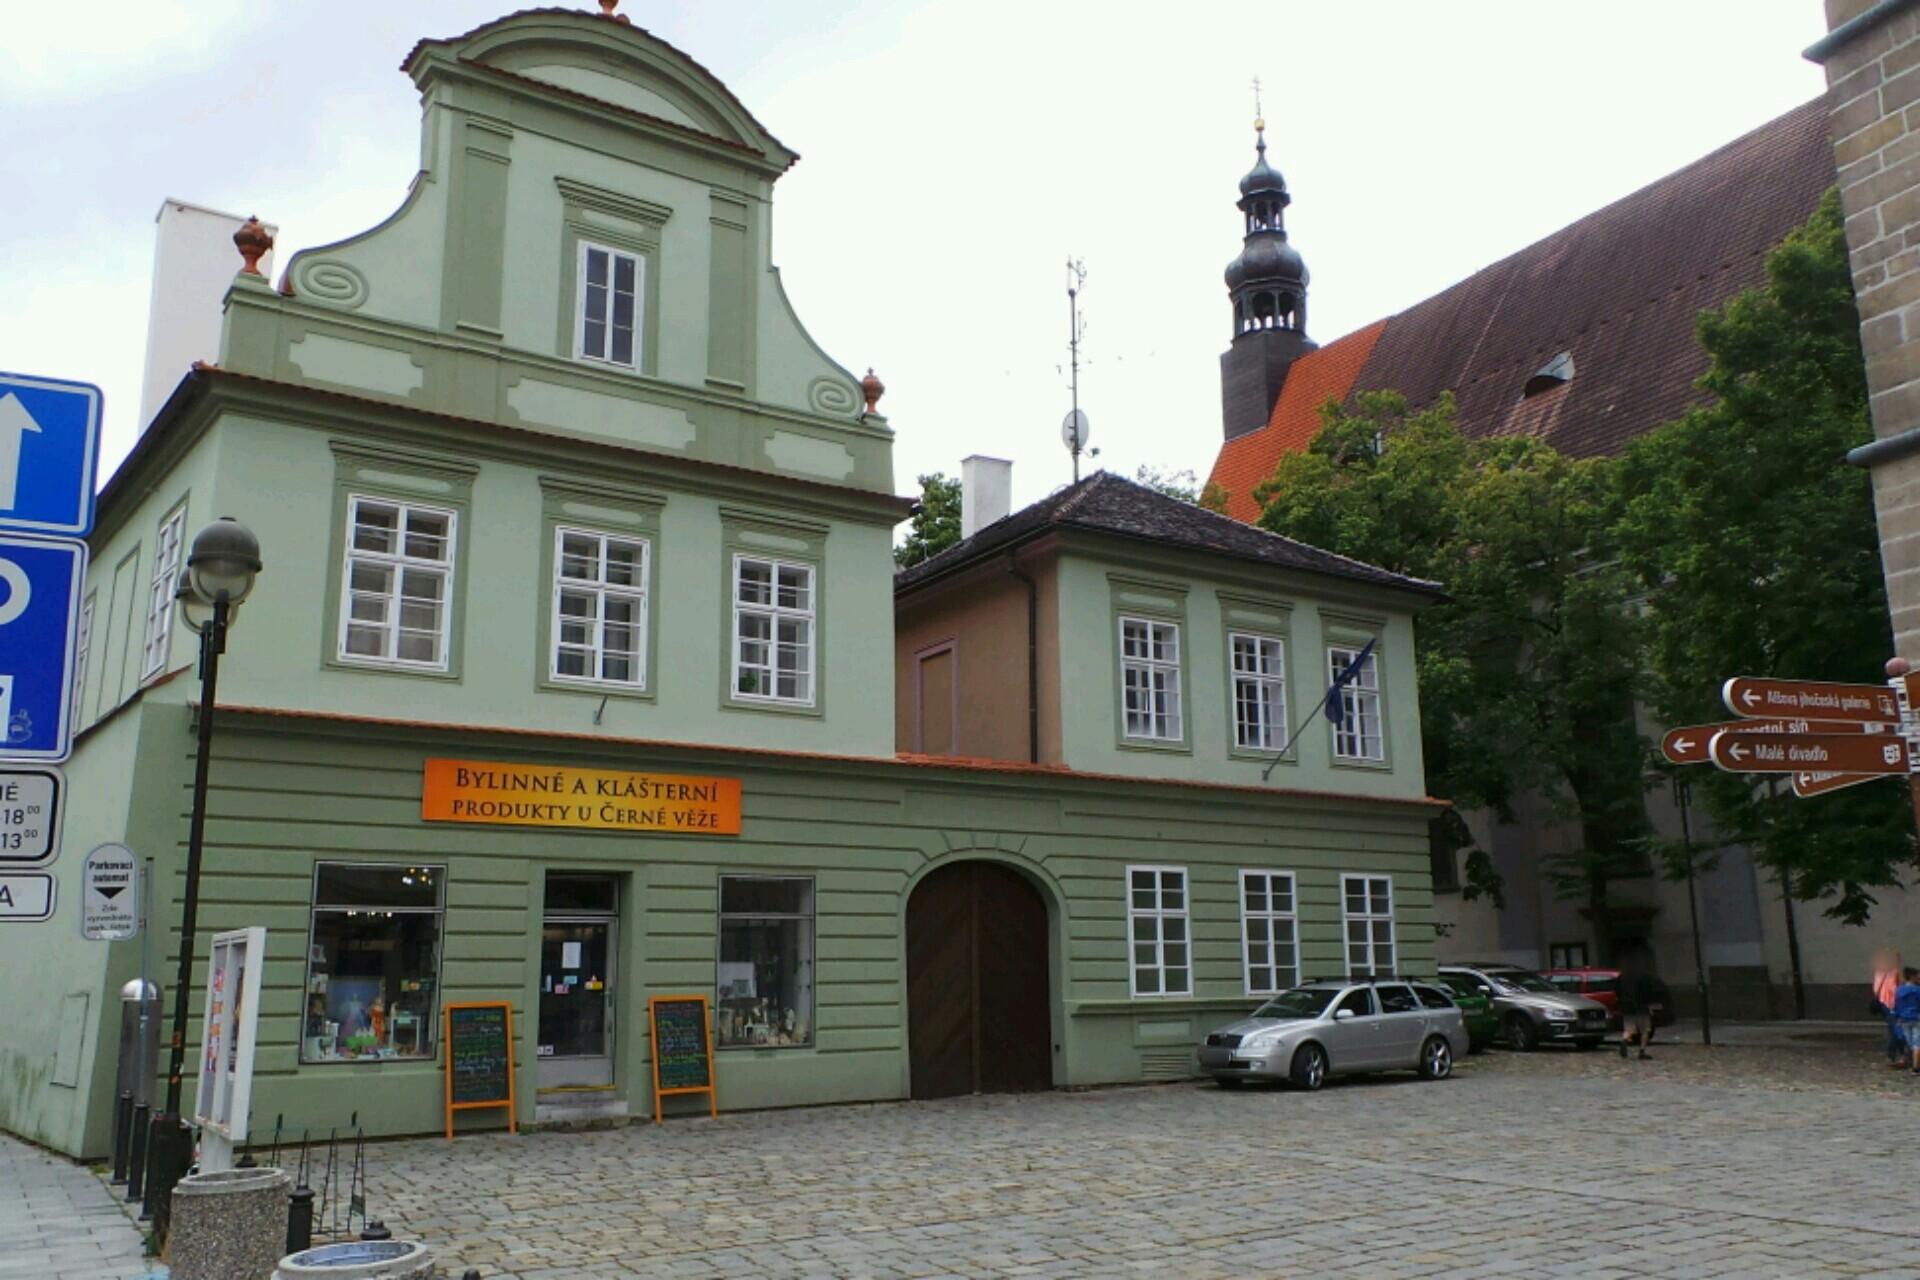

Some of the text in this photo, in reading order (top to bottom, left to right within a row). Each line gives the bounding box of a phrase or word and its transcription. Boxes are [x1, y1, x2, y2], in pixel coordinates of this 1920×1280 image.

[1755, 744, 1829, 762] Malé divadlo
[456, 767, 719, 802] BYLINNÉ A KLÁŠTERNÍ
[453, 799, 720, 828] PRODUKTY U ČERNÉ VĚŽE
[93, 873, 129, 882] automat
